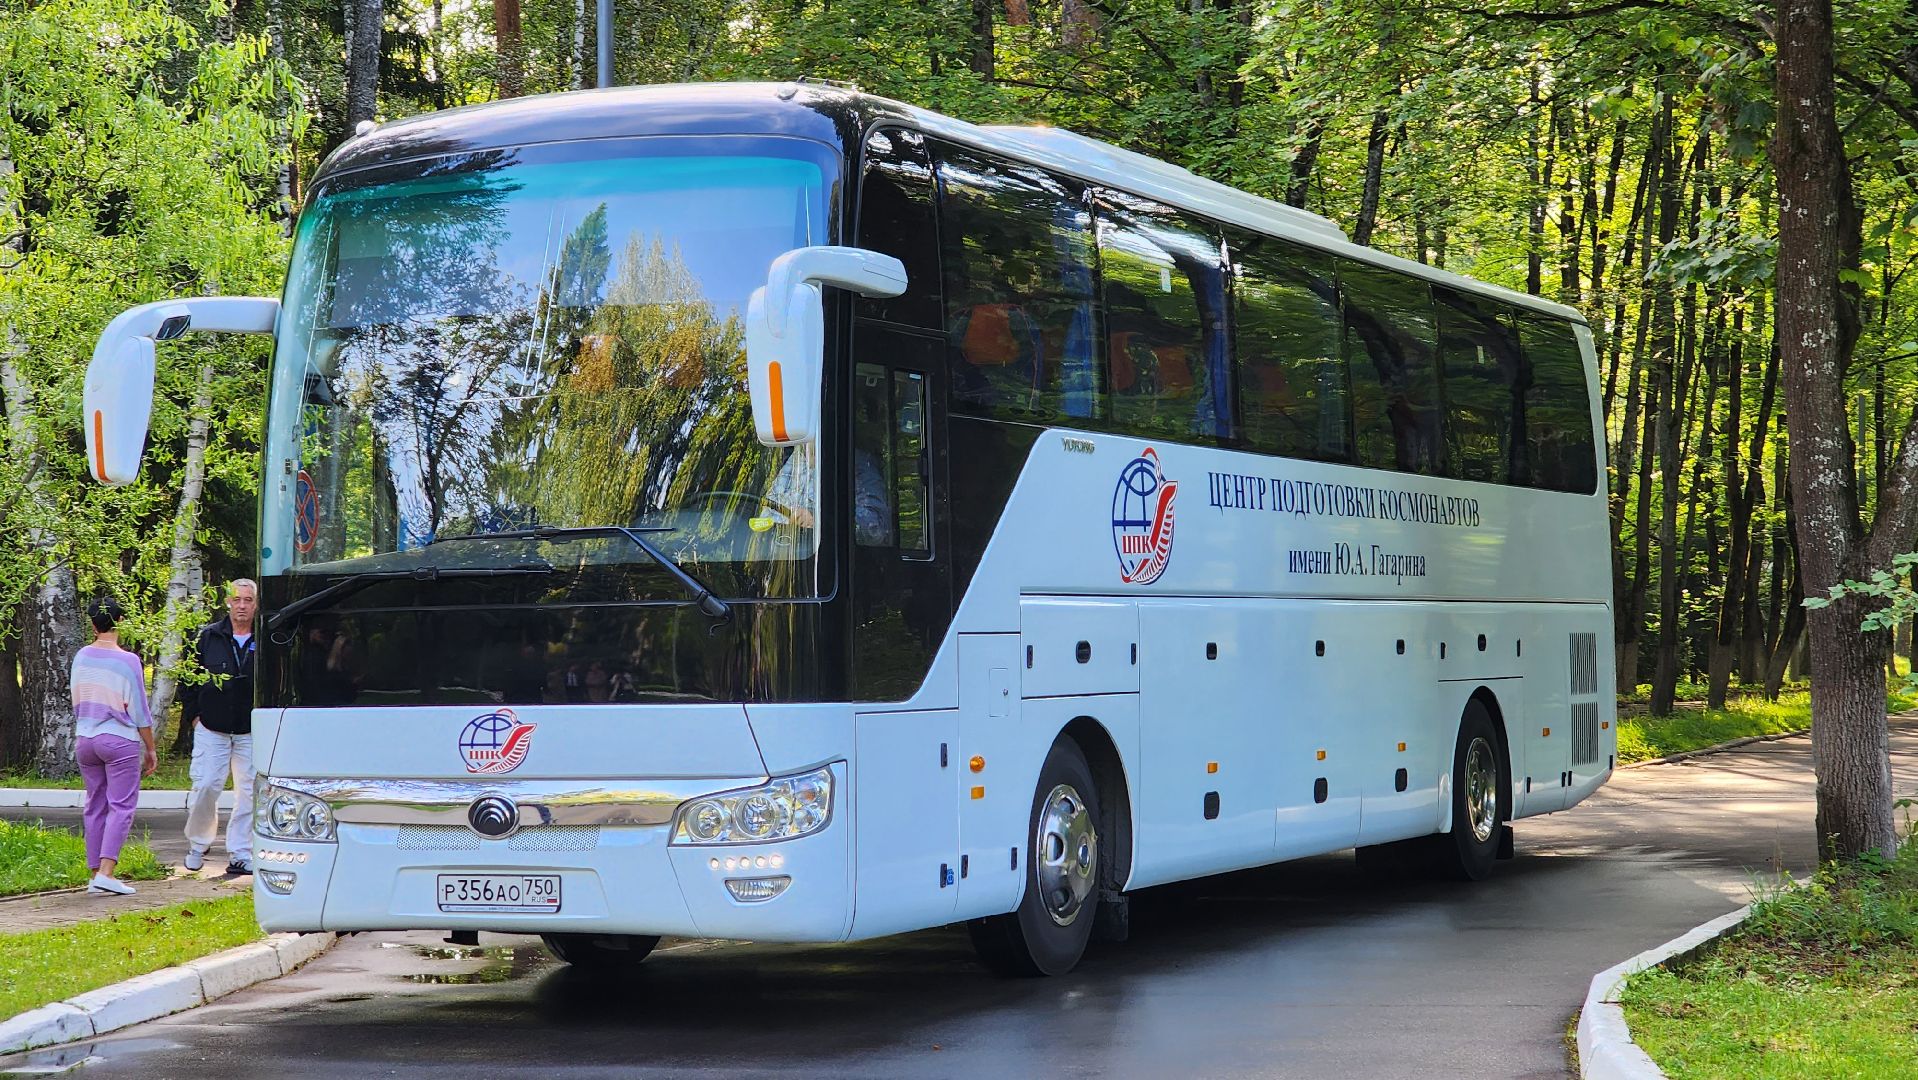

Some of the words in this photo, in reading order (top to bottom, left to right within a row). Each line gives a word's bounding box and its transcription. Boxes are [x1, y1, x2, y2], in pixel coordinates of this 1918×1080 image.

[1208, 471, 1266, 517] ЦЕНТР
[1270, 478, 1376, 520] ПОДГОТОВКИ
[1378, 489, 1480, 527] КОСМОНАВТОВ
[1122, 535, 1151, 555] ЦПК
[1288, 550, 1331, 575] имени
[1334, 542, 1368, 575] Ю.А.
[1371, 544, 1426, 586] Гагарина
[524, 878, 553, 896] 750
